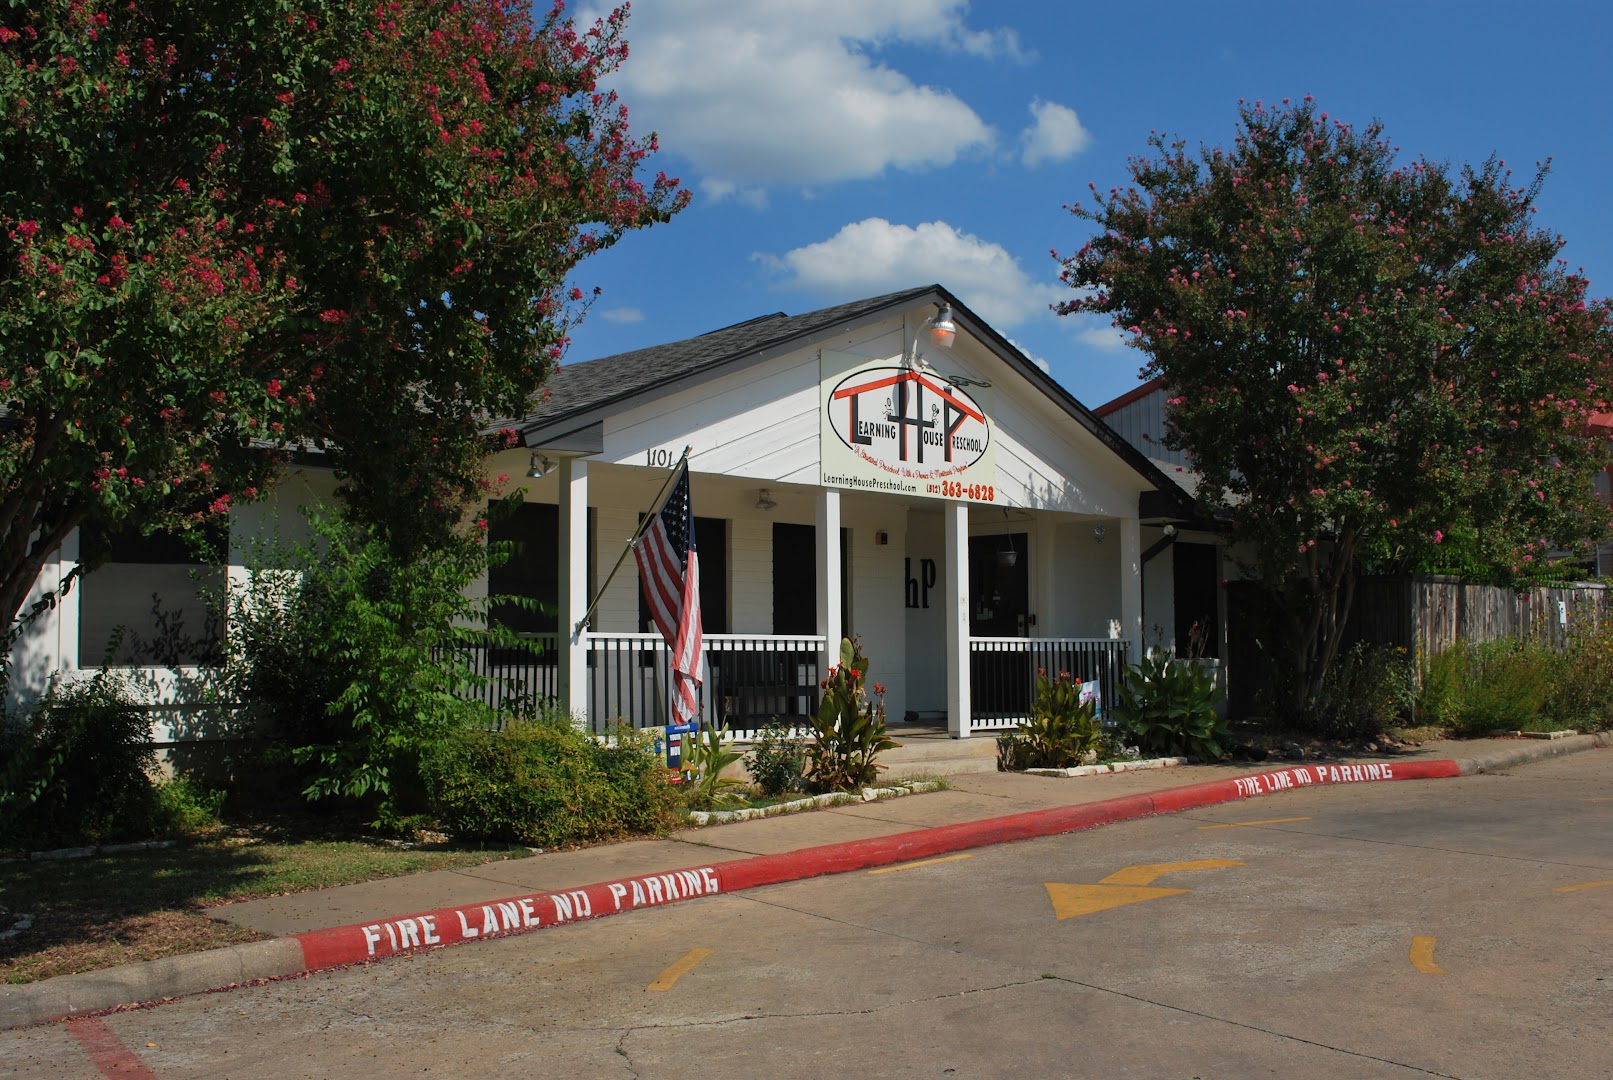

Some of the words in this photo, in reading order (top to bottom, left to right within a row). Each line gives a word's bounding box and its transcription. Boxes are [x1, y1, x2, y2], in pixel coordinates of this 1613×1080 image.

[823, 472, 917, 492] LearningHousePreschool.com
[926, 483, 941, 494] (512)
[942, 480, 994, 501] 363-6828
[1233, 776, 1263, 796] FIRE
[1262, 771, 1293, 790] LANE
[1292, 768, 1312, 784] NO
[1316, 763, 1393, 782] PARKING
[362, 914, 441, 955] FIRE
[455, 898, 540, 938] LANE
[550, 890, 592, 922] NO
[608, 867, 719, 909] PARKING
